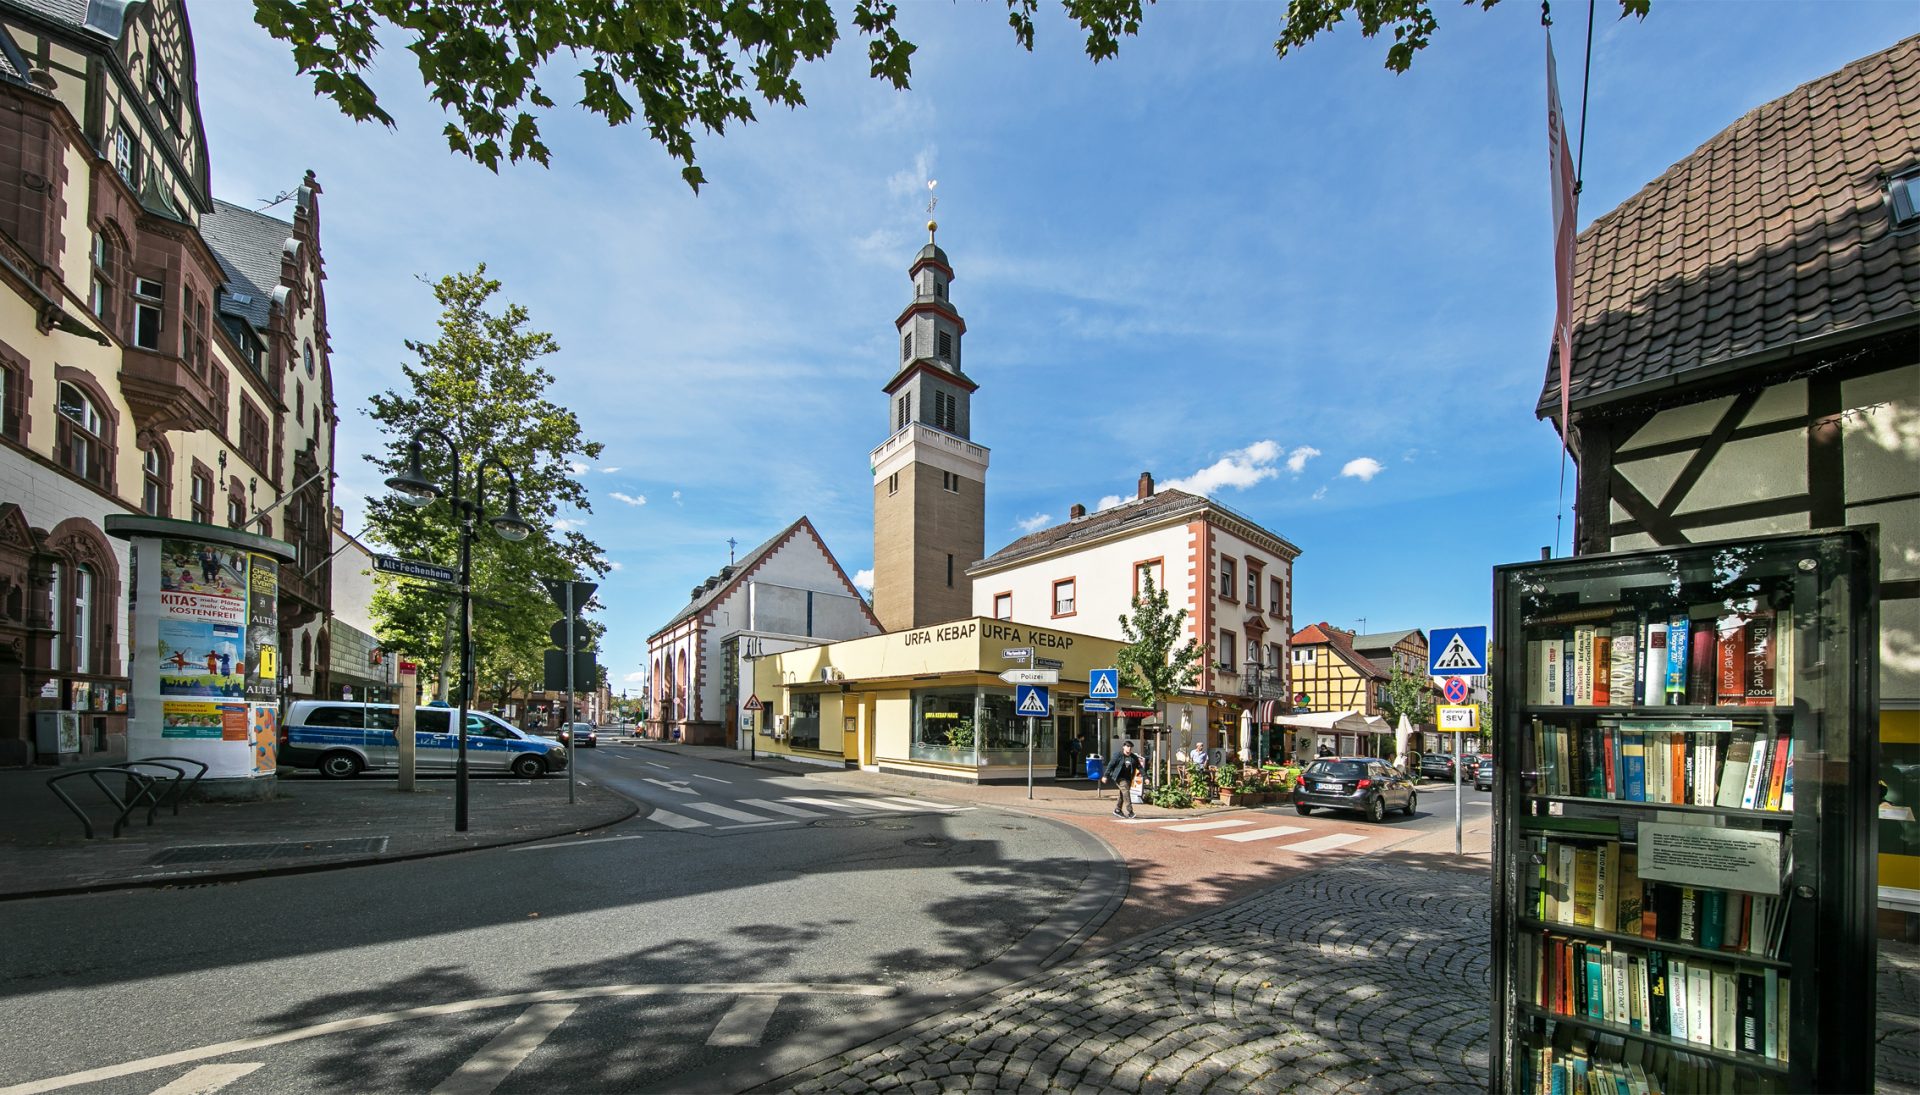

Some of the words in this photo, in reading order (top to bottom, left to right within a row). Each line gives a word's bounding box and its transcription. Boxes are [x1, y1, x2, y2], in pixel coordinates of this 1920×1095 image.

[383, 560, 451, 580] Alt-Fechenheim
[161, 594, 198, 607] KITAS
[169, 606, 236, 619] KOSTENFREI!
[905, 631, 932, 646] URFA
[936, 623, 976, 641] KEBAP
[982, 623, 1021, 643] URFA
[1029, 631, 1074, 650] KEBAP
[1724, 643, 1737, 670] Server
[1724, 671, 1735, 690] 2010
[1753, 660, 1768, 689] Server
[1746, 689, 1774, 697] 2004
